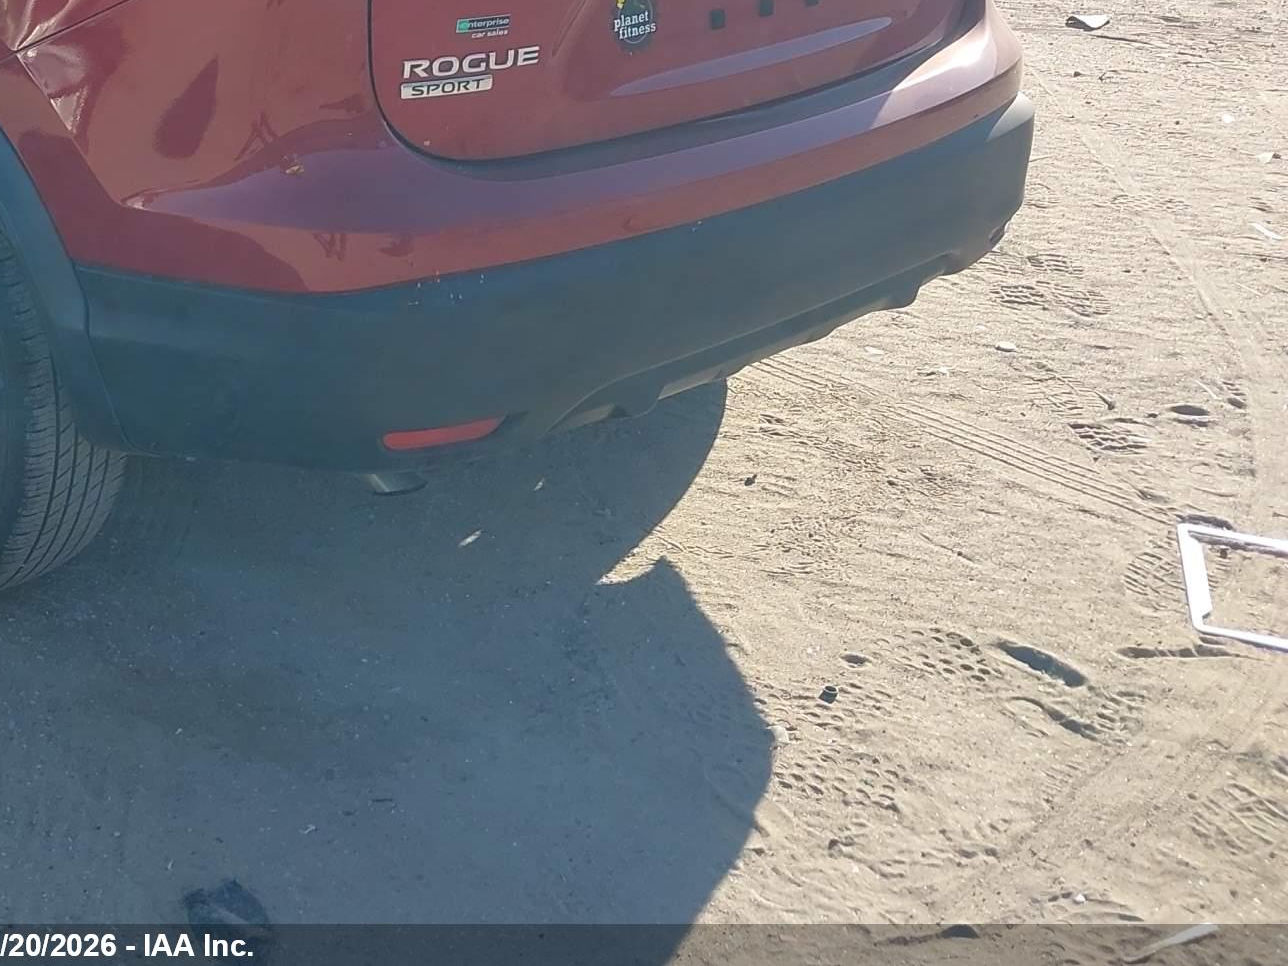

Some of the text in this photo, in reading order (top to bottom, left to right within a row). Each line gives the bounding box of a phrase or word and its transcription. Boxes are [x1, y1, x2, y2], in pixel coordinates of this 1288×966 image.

[614, 10, 649, 32] planet
[487, 28, 508, 37] sales
[619, 22, 657, 40] fitness
[403, 46, 540, 79] ROGUE
[411, 78, 485, 96] SPORT
